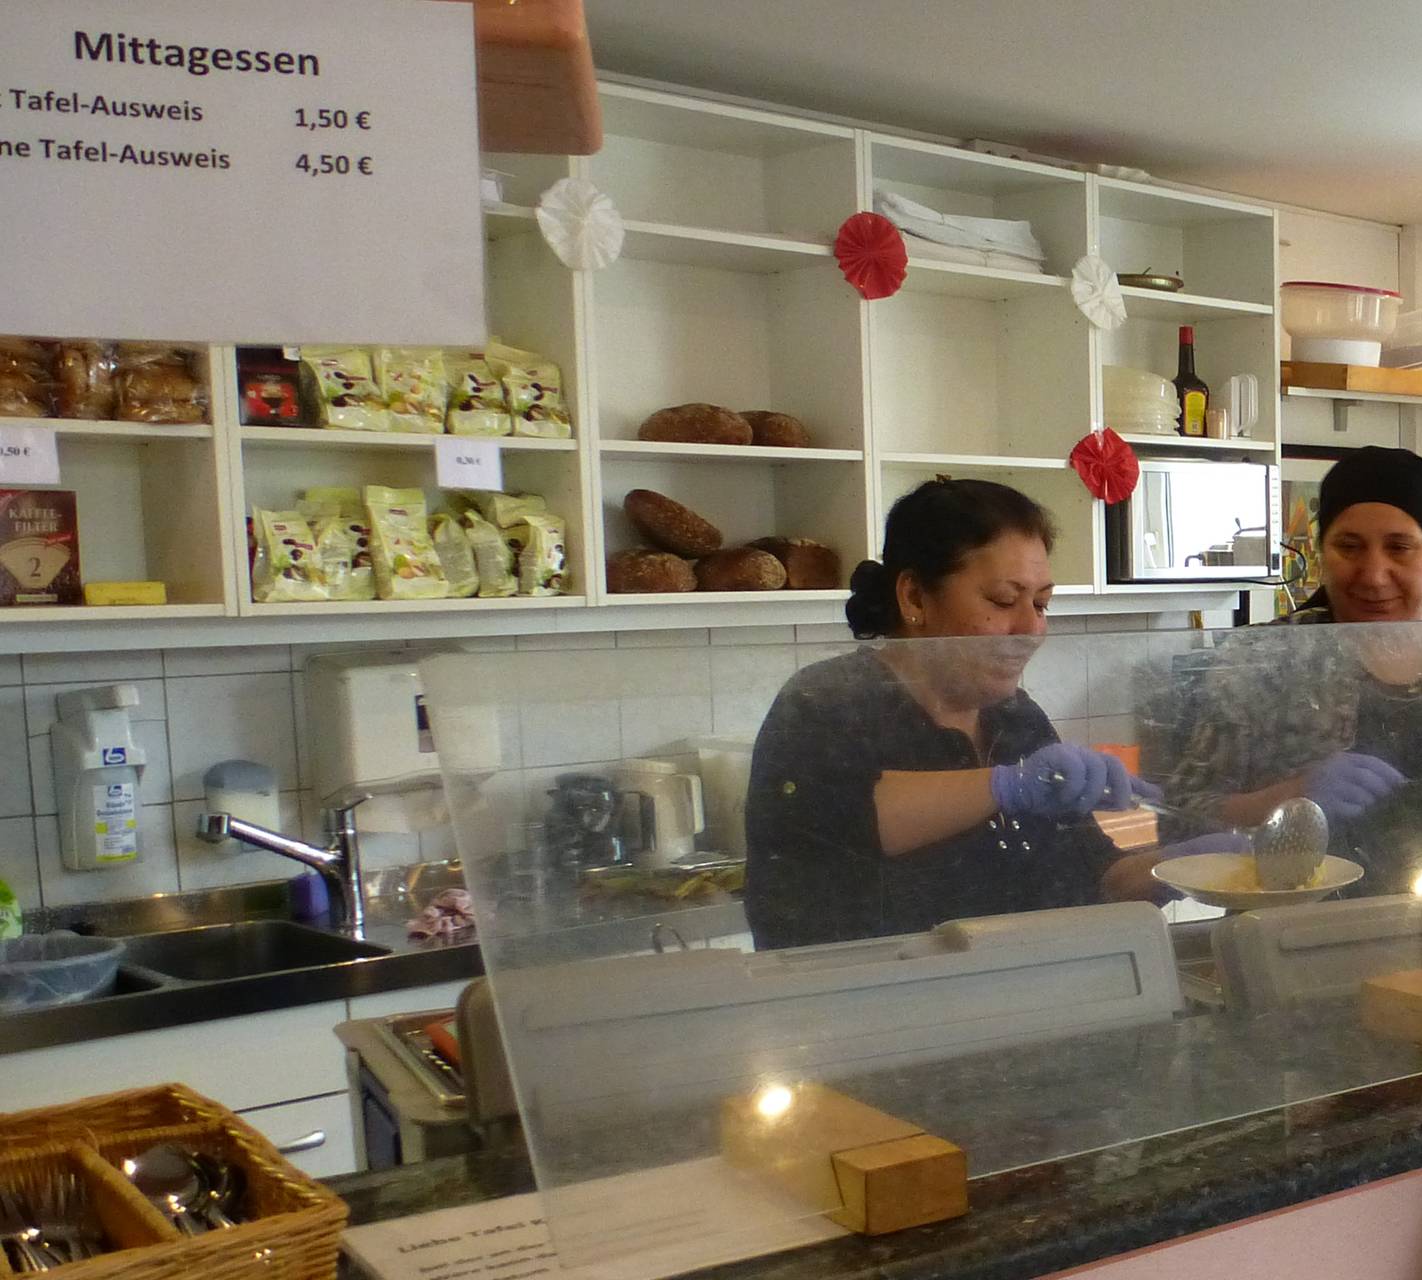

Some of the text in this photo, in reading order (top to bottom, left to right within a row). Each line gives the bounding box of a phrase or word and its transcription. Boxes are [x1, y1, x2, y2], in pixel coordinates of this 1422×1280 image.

[74, 31, 319, 76] Mittagessen
[9, 89, 203, 121] Tafel-Ausweis
[296, 108, 347, 131] 1,50
[355, 111, 371, 130] €
[38, 139, 230, 169] Tafel-Ausweis
[296, 154, 349, 176] 4,50
[358, 157, 372, 175] €
[14, 521, 58, 533] FILTER
[29, 556, 41, 578] 2
[467, 1221, 526, 1238] Tafel
